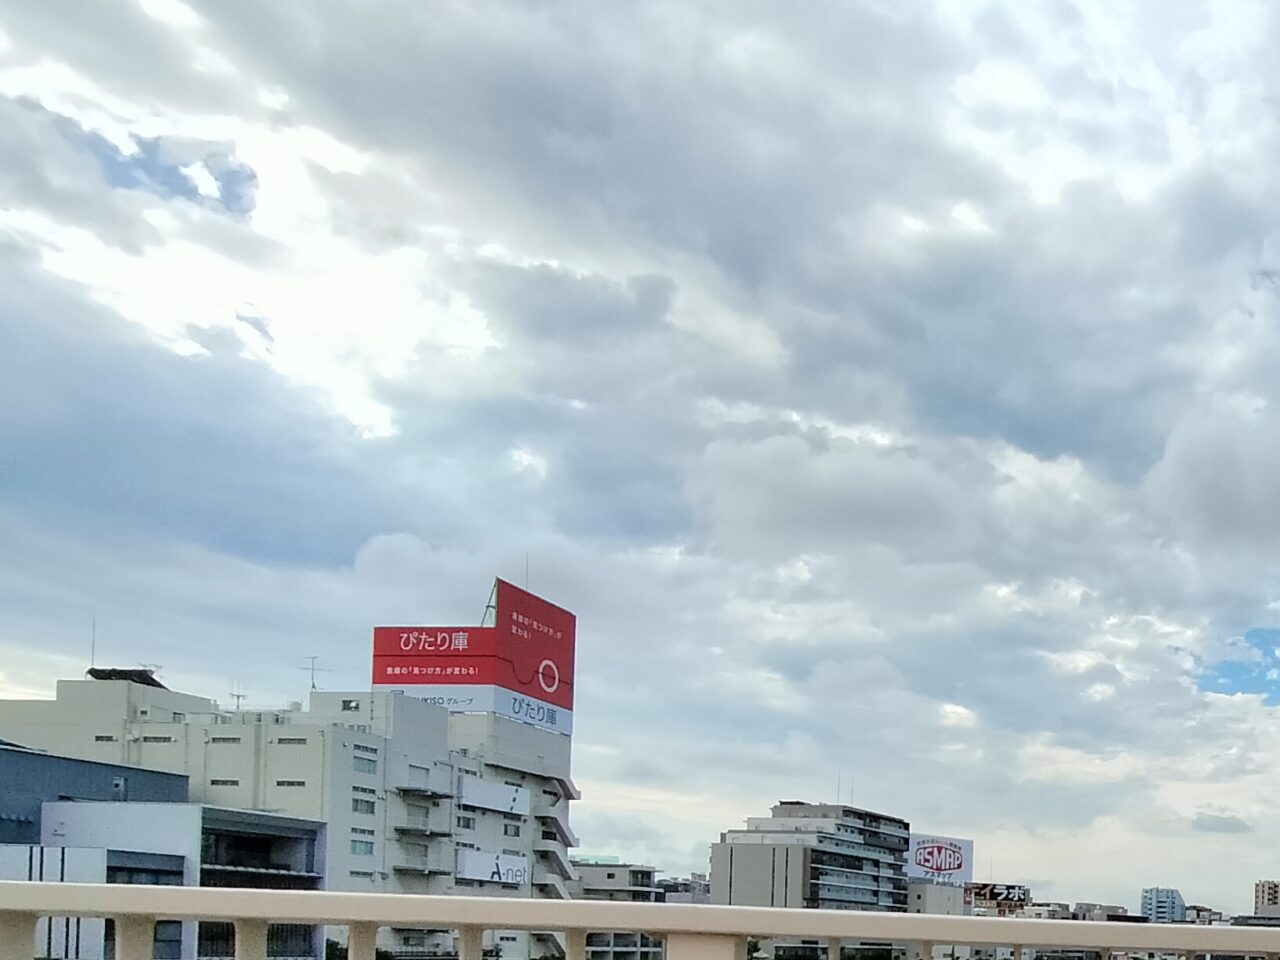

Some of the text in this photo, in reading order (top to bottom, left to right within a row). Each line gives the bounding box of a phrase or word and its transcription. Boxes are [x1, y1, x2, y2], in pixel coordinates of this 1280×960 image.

[400, 632, 469, 651] ぴたり庫
[511, 698, 557, 726] ぴたり庫
[916, 847, 963, 870] ASMAP
